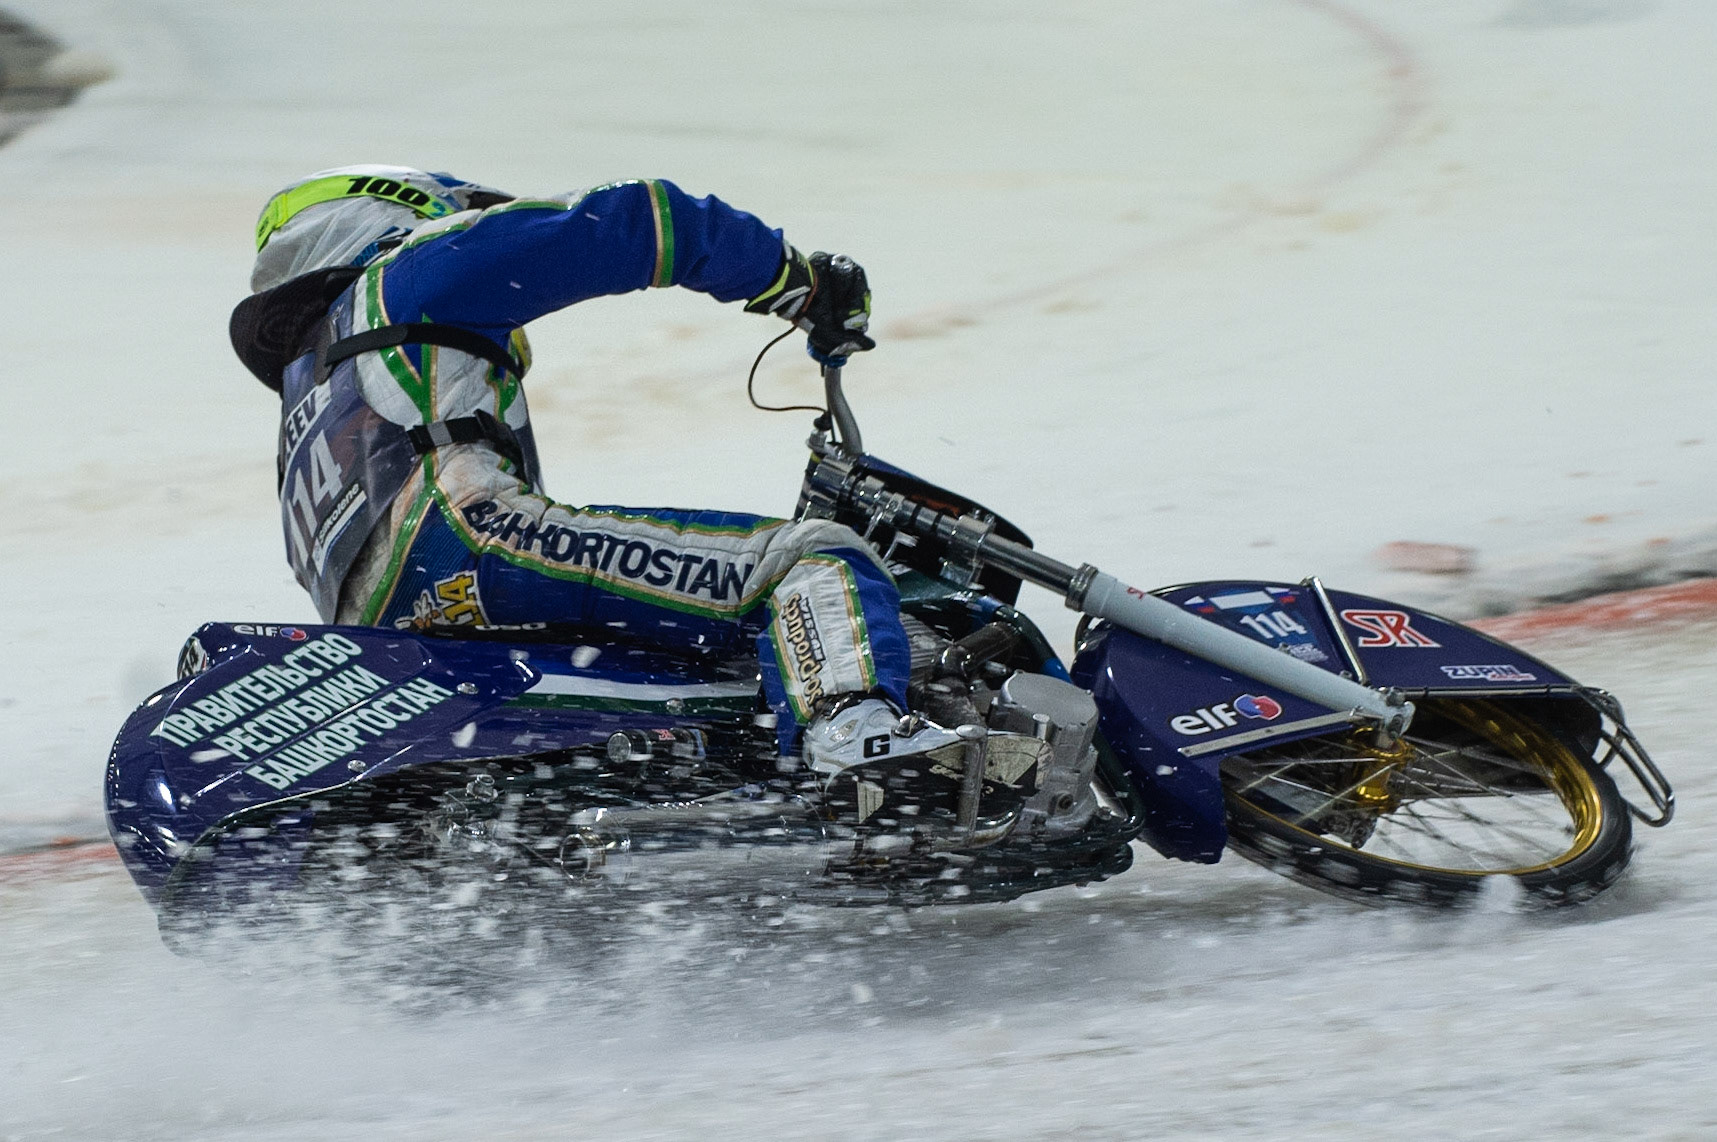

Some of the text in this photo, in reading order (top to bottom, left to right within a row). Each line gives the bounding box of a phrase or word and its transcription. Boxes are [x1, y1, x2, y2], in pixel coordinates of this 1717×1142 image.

[286, 390, 317, 449] EEV
[233, 624, 279, 637] elf
[1240, 611, 1307, 639] 114
[152, 632, 363, 748] ПРАВИТЕЛЬСТВО
[212, 665, 393, 761] РЕСПУБЛИКИ
[1169, 703, 1239, 736] elf
[244, 677, 454, 790] БАШКОРТОСТАН
